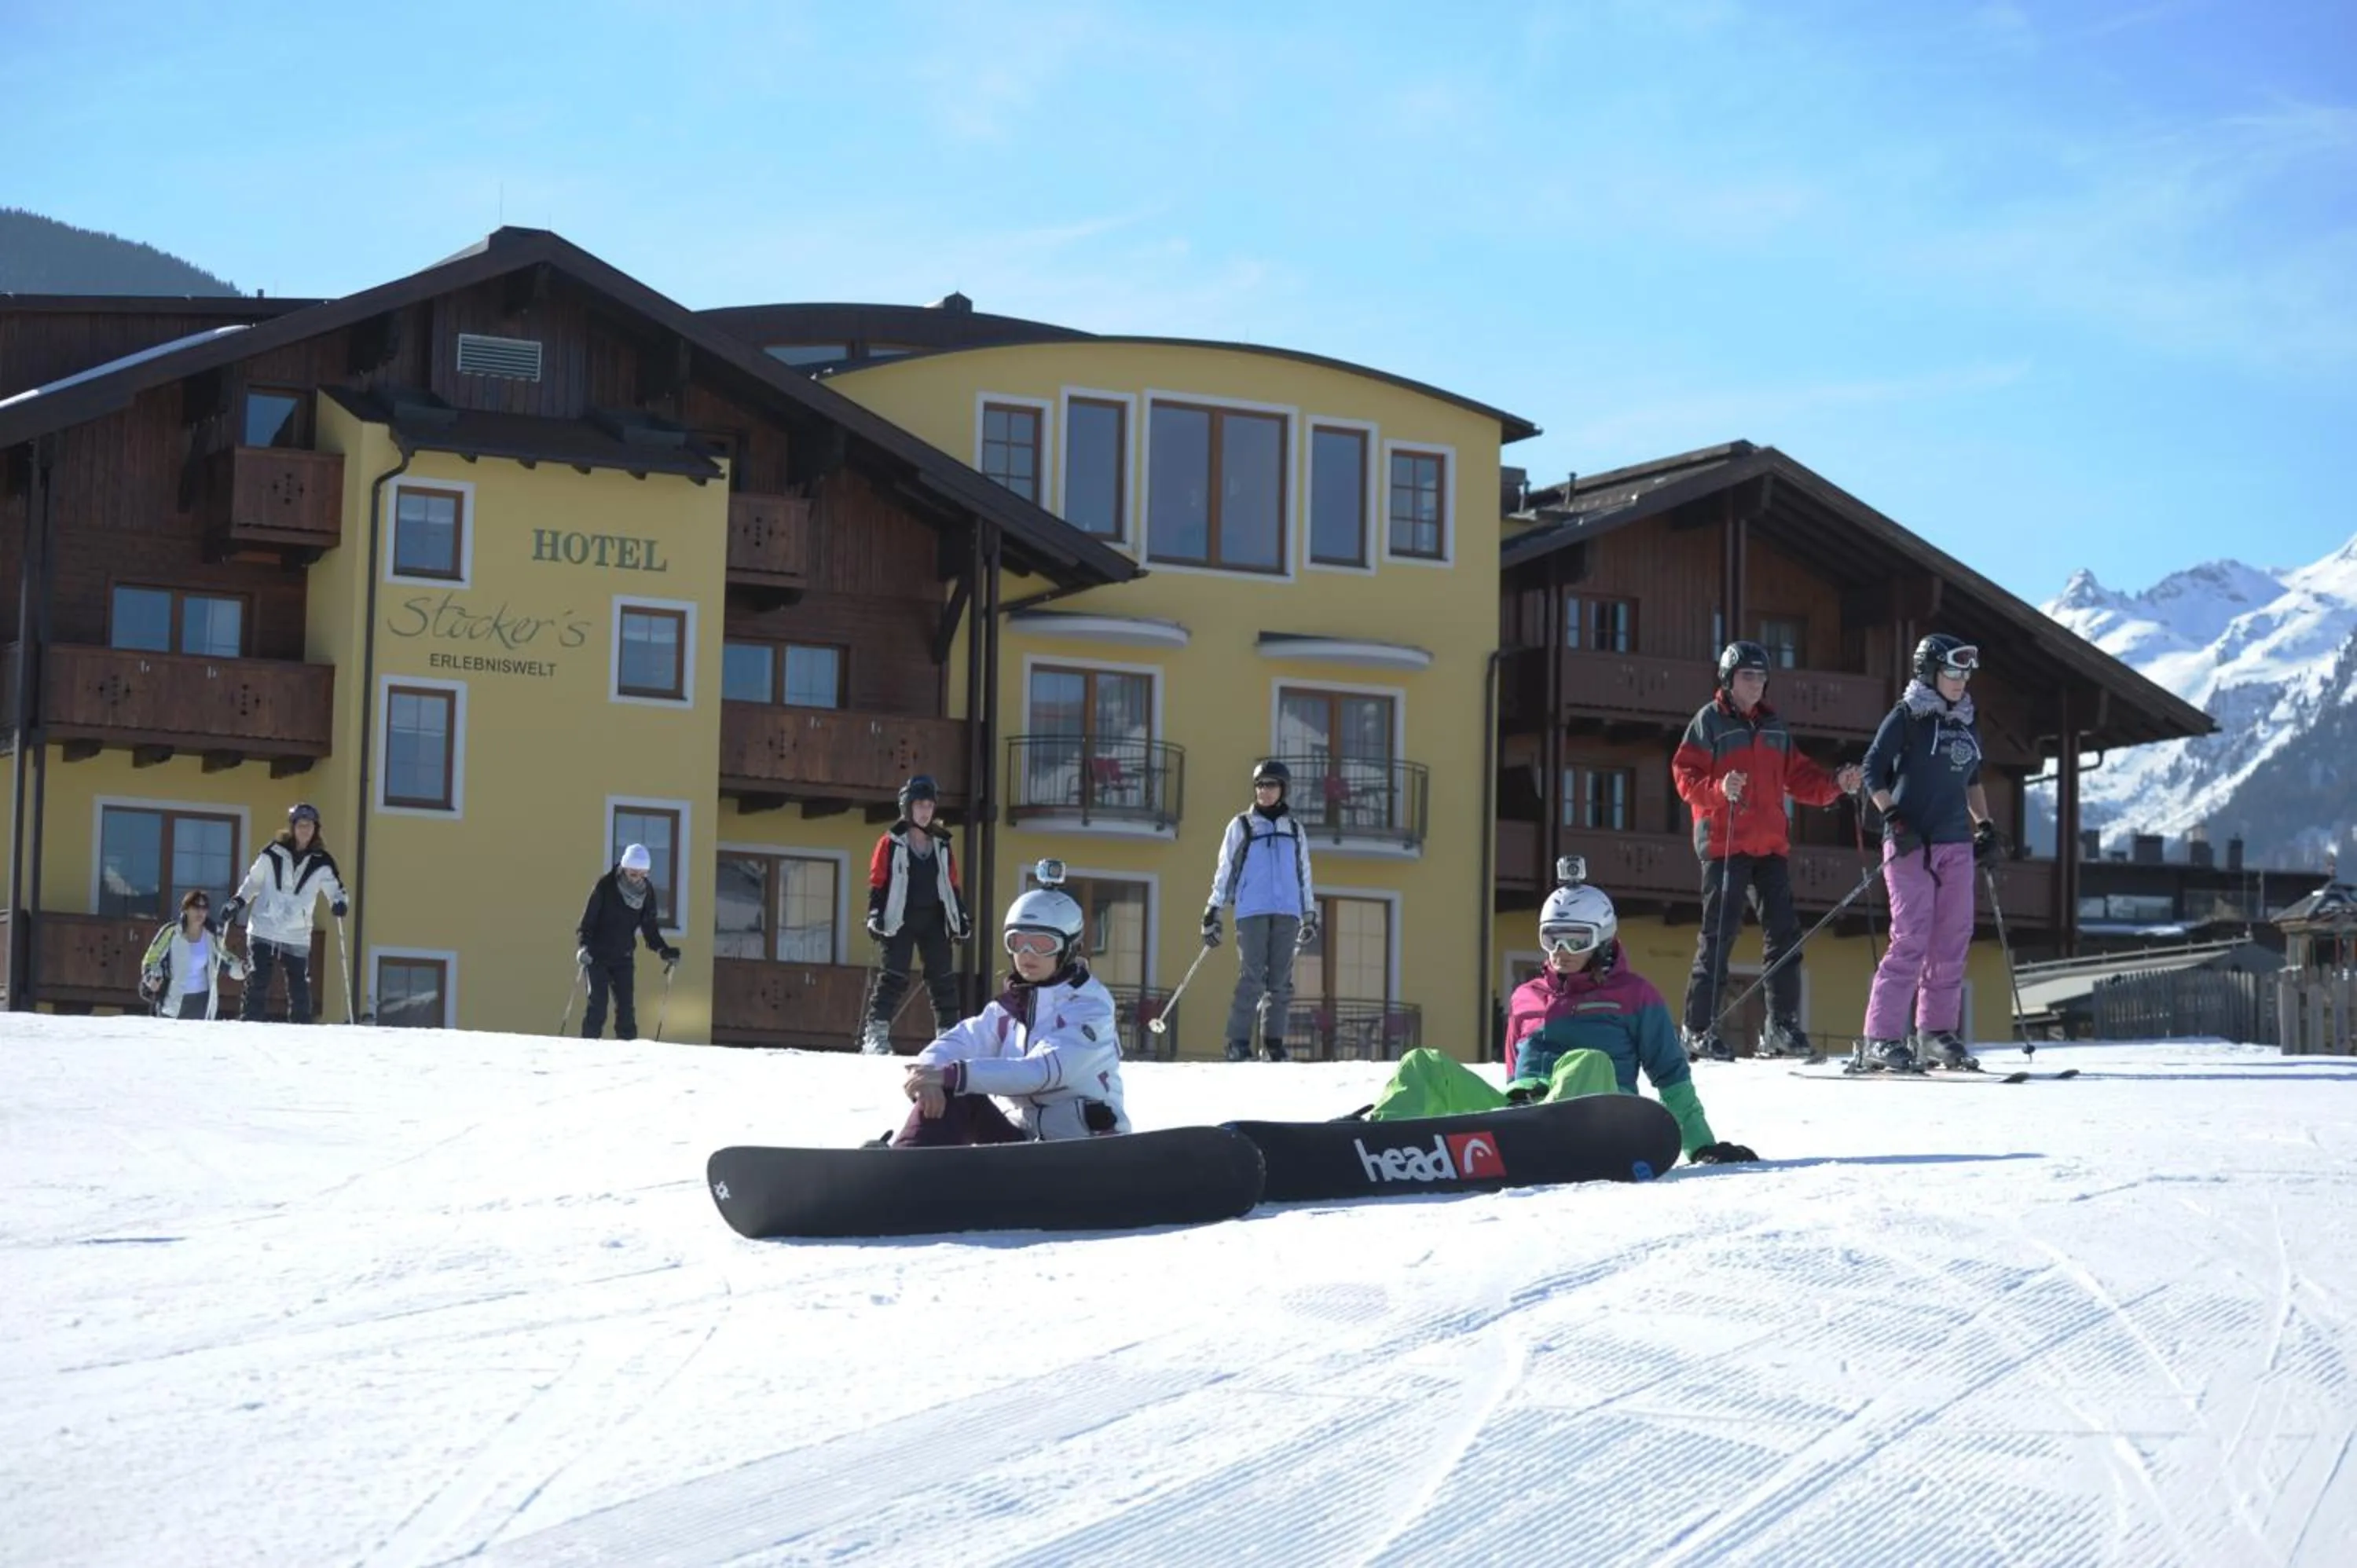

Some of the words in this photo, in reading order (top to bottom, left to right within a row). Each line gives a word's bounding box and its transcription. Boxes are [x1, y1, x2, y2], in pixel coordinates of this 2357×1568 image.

[532, 529, 667, 572] HOTEL
[430, 653, 557, 676] ERLEBNISWELT
[1354, 1134, 1457, 1181] head
